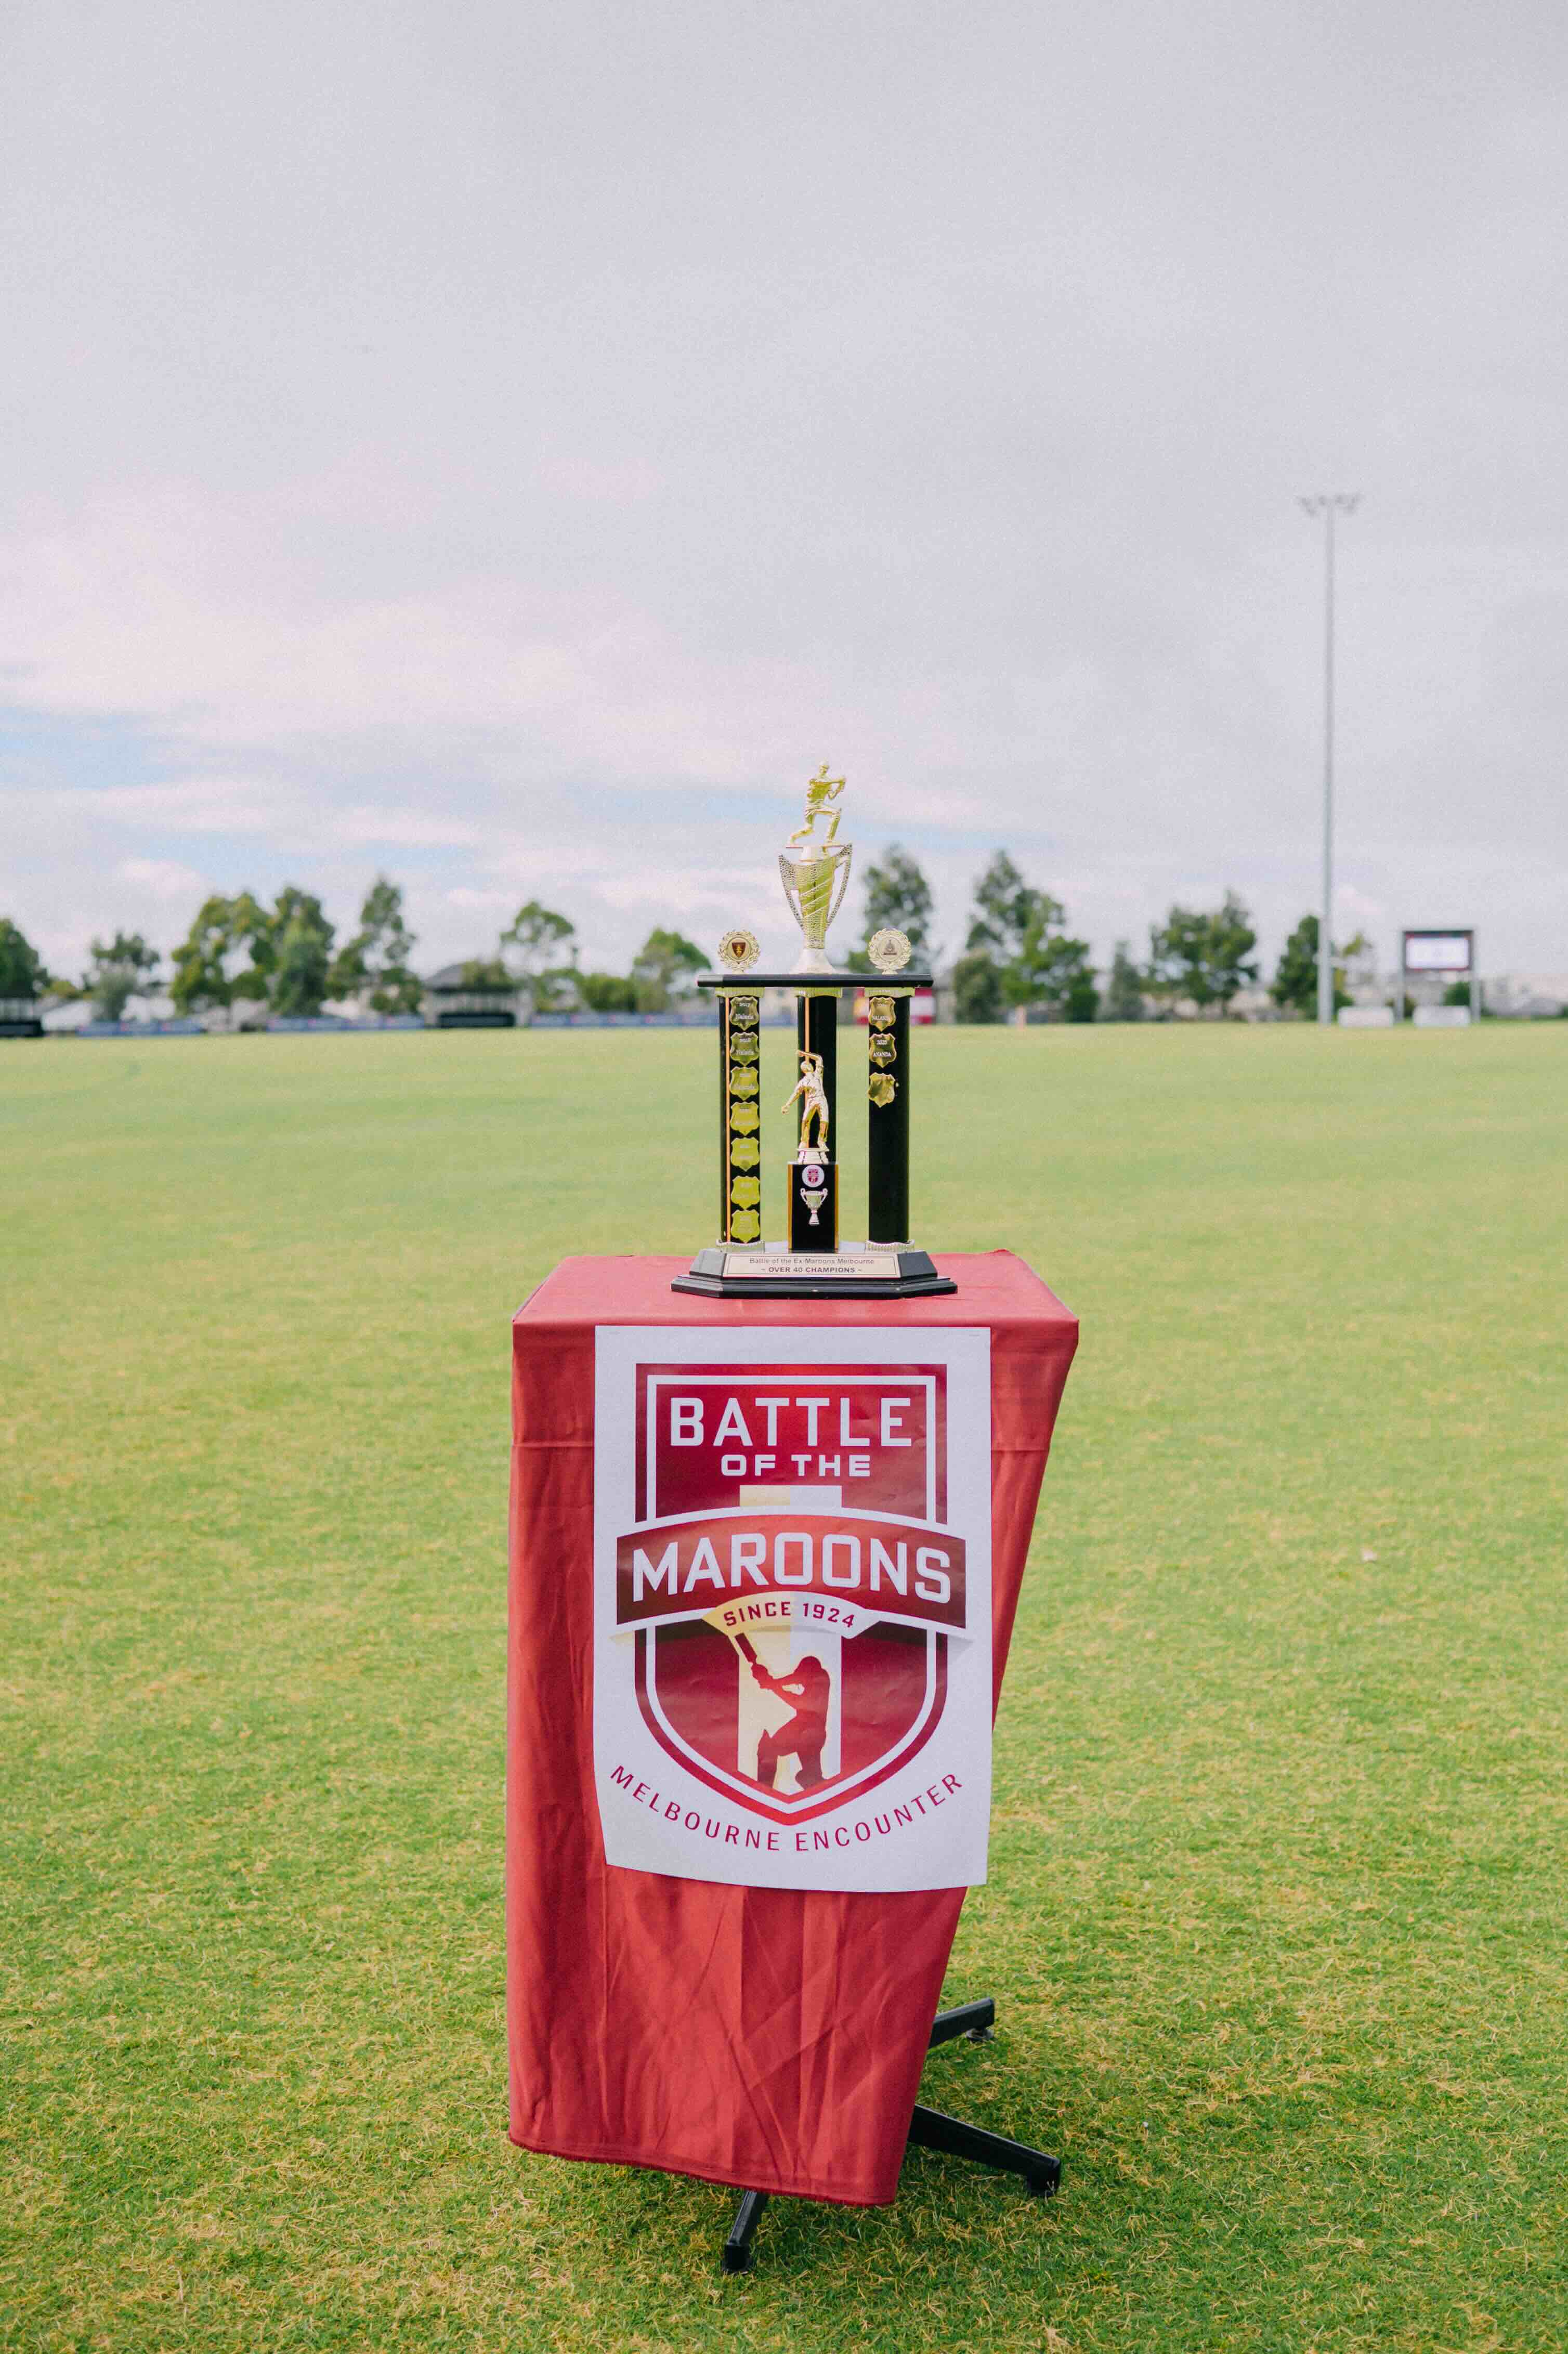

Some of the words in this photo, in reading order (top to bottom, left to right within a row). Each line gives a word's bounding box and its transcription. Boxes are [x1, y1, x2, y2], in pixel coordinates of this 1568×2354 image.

[670, 1397, 912, 1447] BATTLE
[721, 1455, 776, 1476] OF
[791, 1455, 871, 1477] THE
[633, 1532, 951, 1604] MAROONS
[723, 1601, 791, 1627] SINCE
[802, 1602, 856, 1628] 1924
[610, 1764, 780, 1852] MELBOURNE
[795, 1774, 963, 1852] ENCOUNTER
